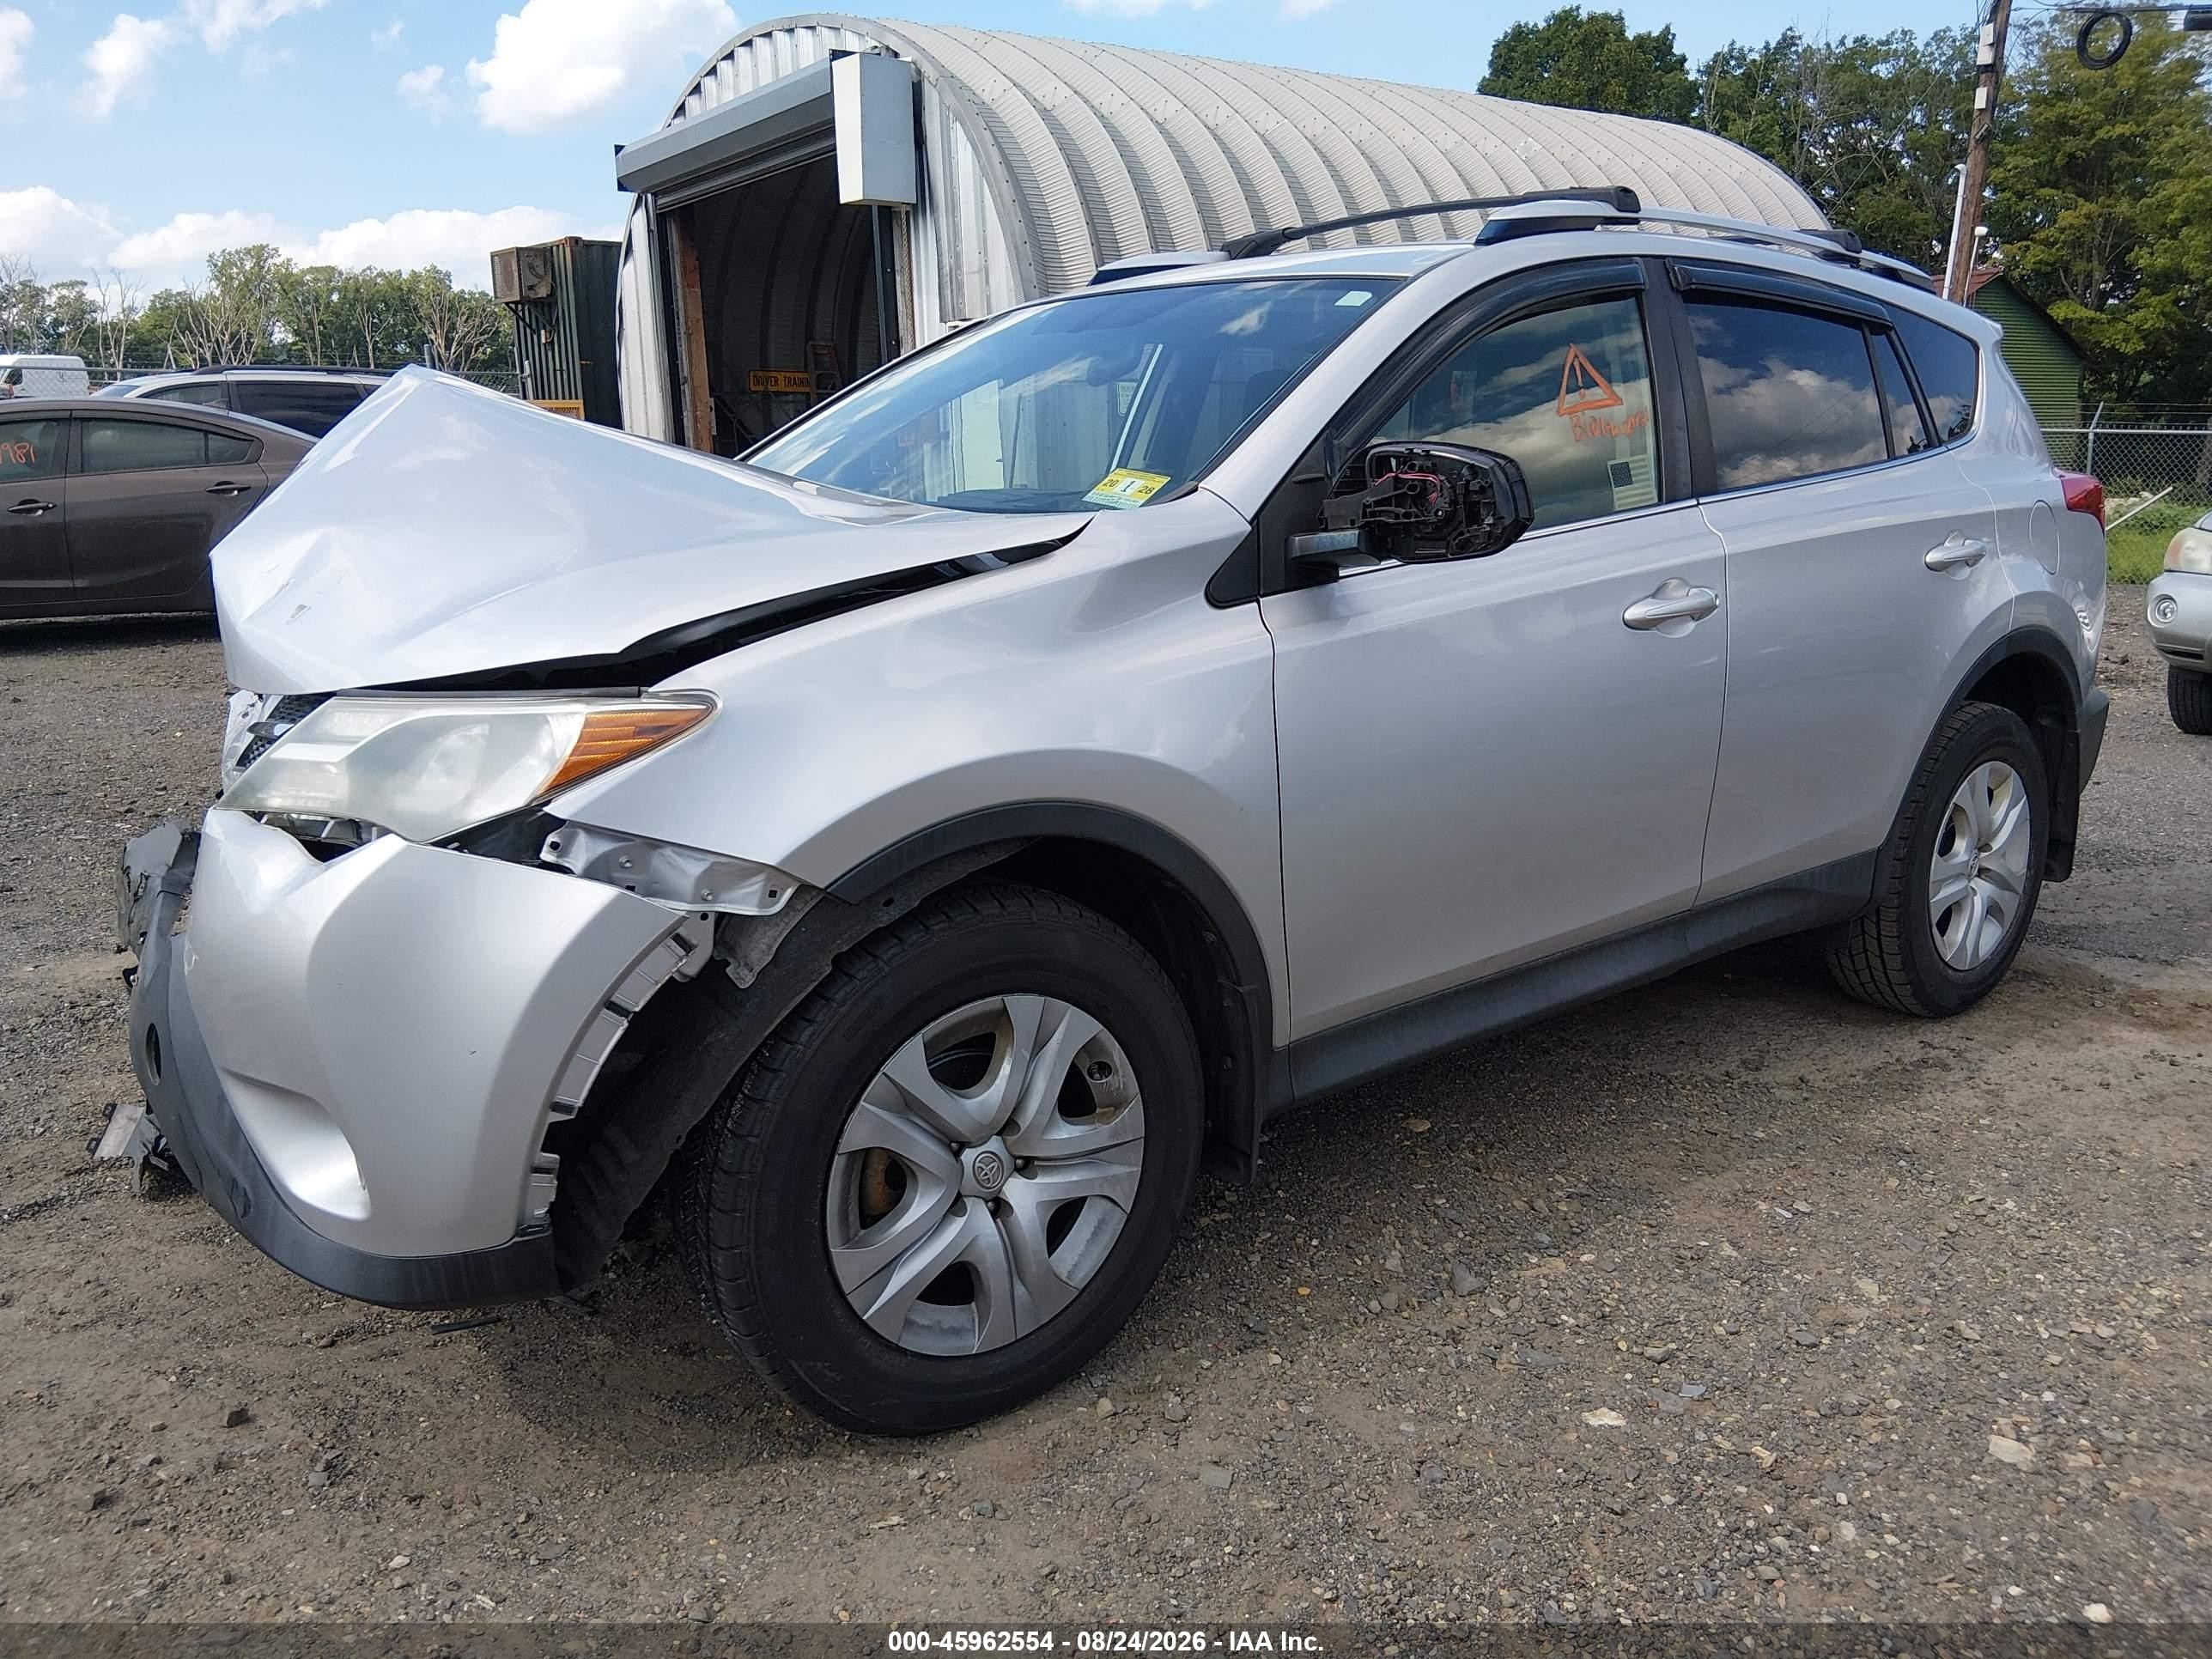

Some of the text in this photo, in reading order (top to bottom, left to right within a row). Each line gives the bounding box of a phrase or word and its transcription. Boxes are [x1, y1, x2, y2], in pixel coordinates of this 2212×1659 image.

[752, 375, 811, 389] DRIVER TRAININ
[0, 442, 35, 465] 981
[1103, 478, 1120, 488] 20
[1138, 485, 1155, 495] 28
